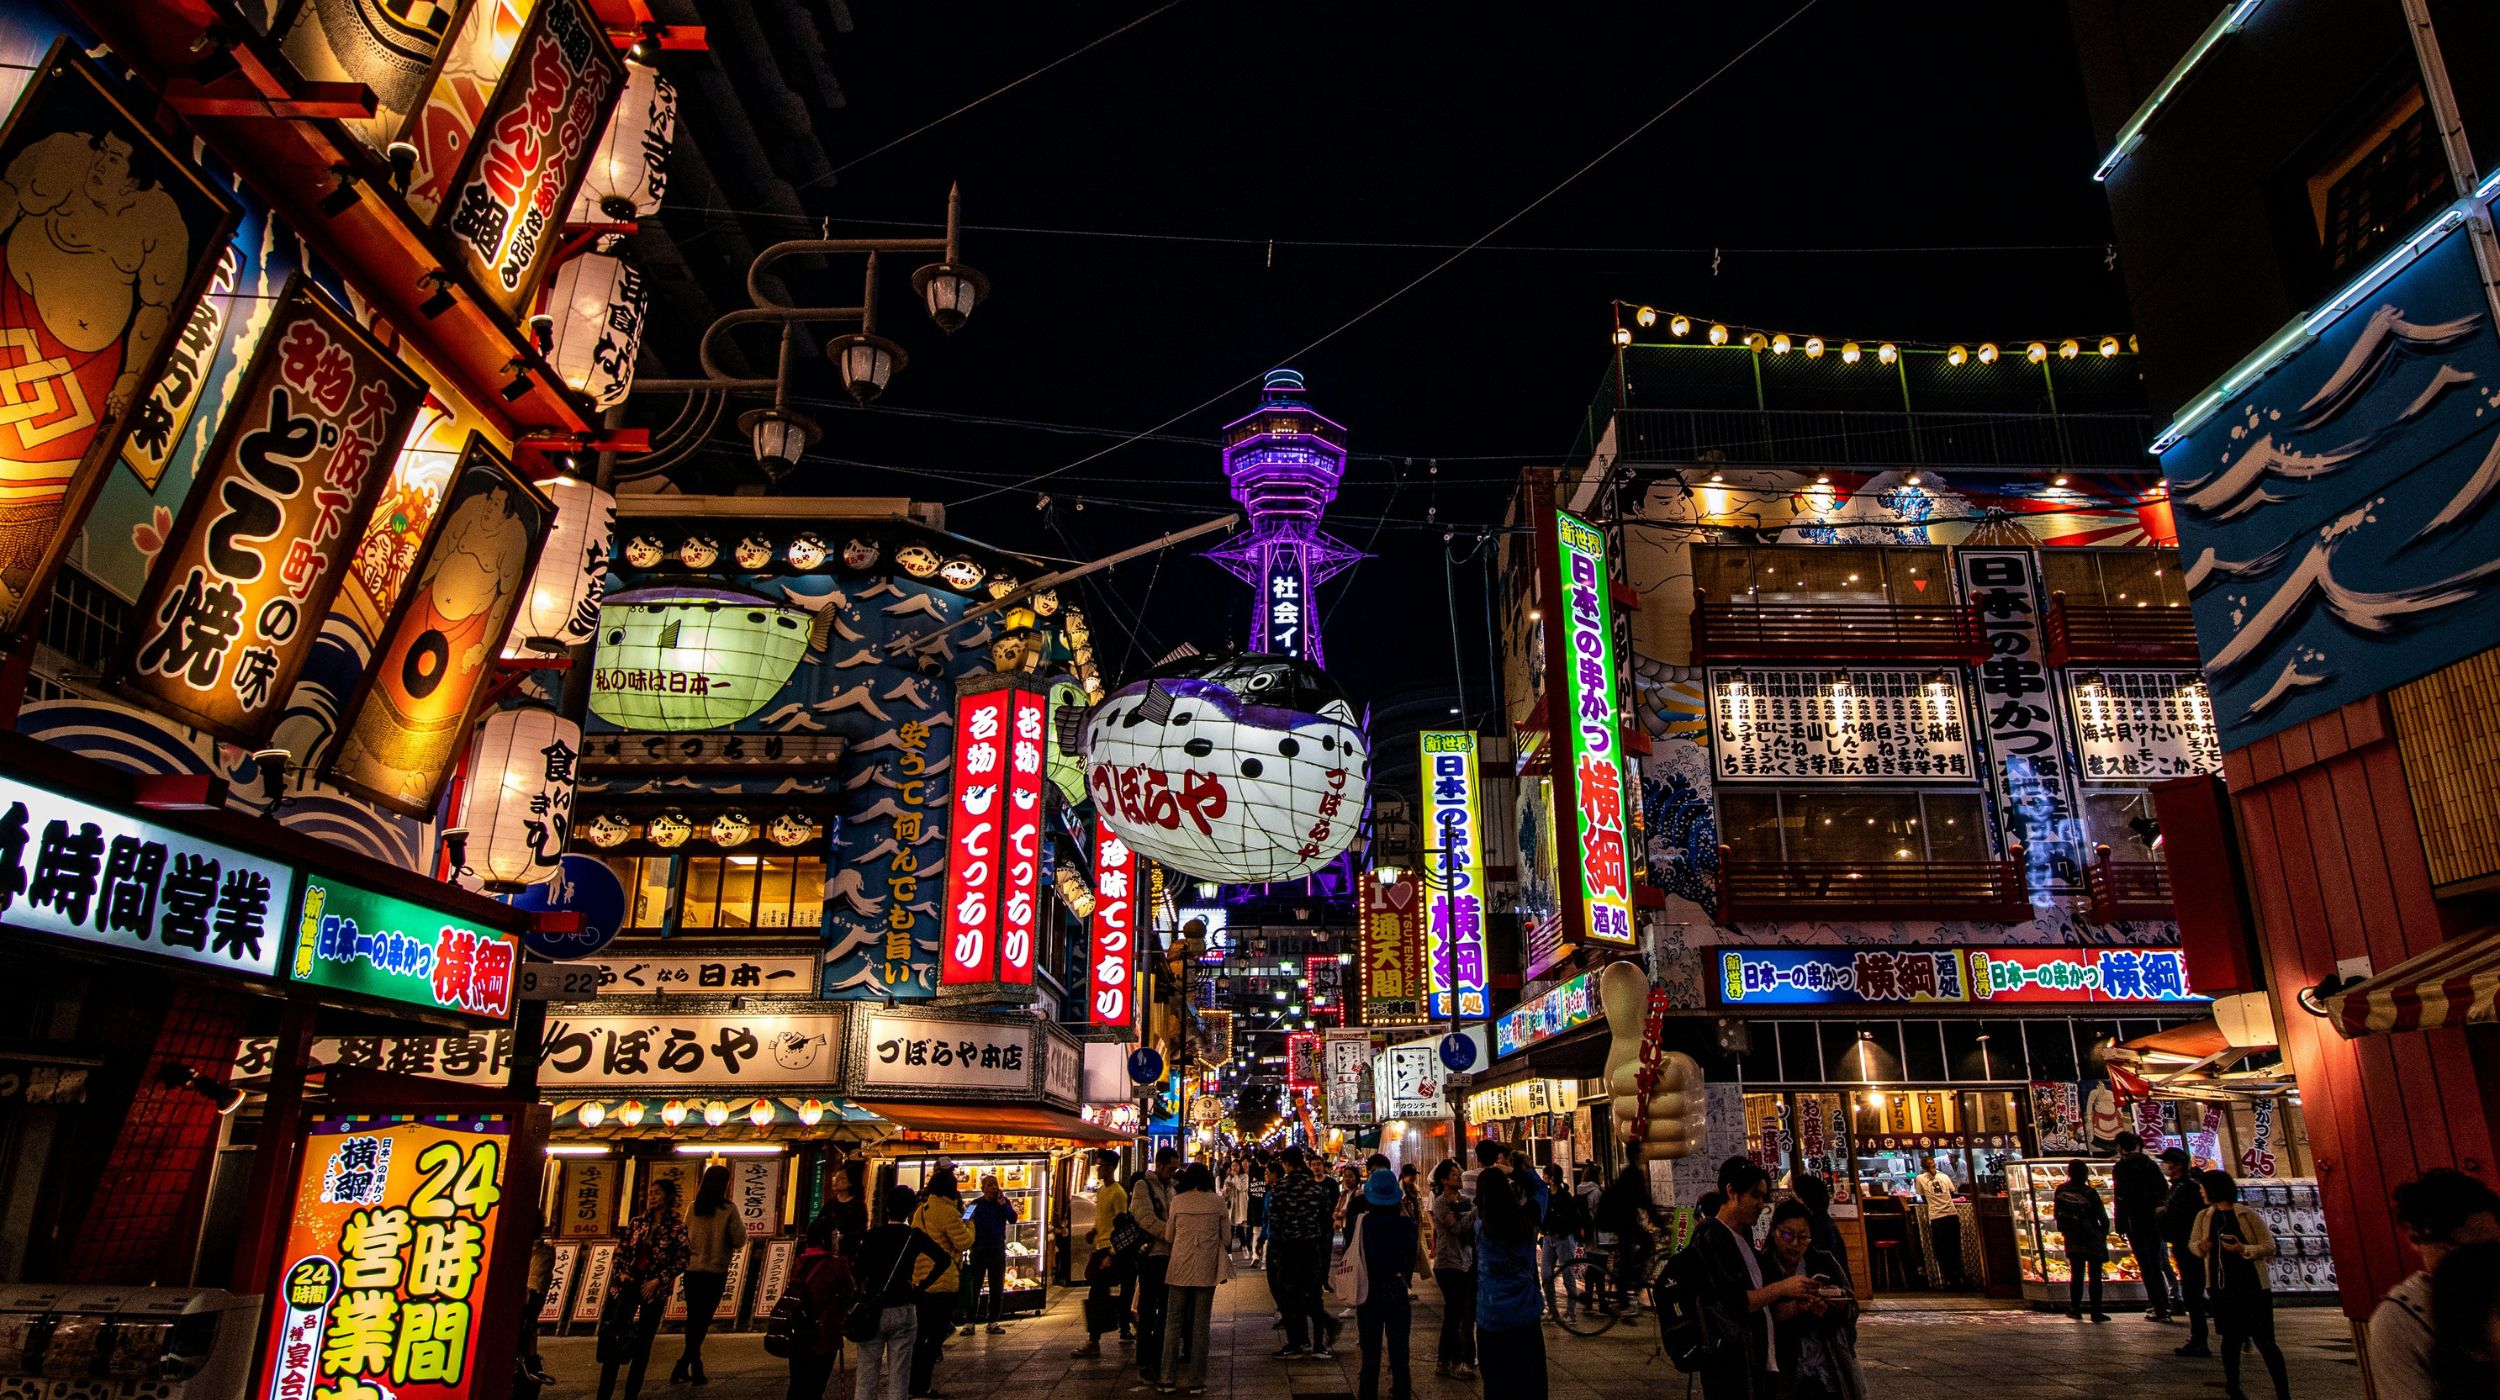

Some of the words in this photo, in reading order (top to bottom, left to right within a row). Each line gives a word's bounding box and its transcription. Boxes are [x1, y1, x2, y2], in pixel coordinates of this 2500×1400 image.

[1559, 518, 1602, 559] 新世界
[1272, 576, 1299, 658] 社会イ
[1570, 551, 1611, 752] 日本一の串かつ
[1969, 556, 2054, 755] 日本一の串かつ
[966, 705, 998, 774] 名物
[1014, 706, 1041, 774] 名物
[1424, 734, 1473, 753] 新世界
[1719, 722, 1740, 775] もち
[1738, 722, 1758, 775] うずら玉子
[1755, 722, 1776, 775] 紅しょうが
[1772, 722, 1792, 775] にんにく
[1789, 722, 1810, 775] 玉ねぎ
[1806, 722, 1826, 775] 山芋
[1824, 722, 1844, 775] しし唐
[1841, 722, 1862, 775] れんこん
[1859, 722, 1880, 775] 銀杏
[1876, 722, 1897, 775] 白ねぎ
[1893, 722, 1914, 775] さつま芋
[1910, 722, 1931, 775] じゃが芋
[1927, 722, 1949, 775] 茄子
[1945, 722, 1966, 775] 椎茸
[1998, 754, 2059, 778] 大阪
[2082, 723, 2104, 775] 海老
[2101, 723, 2123, 774] キス
[2117, 723, 2139, 774] 貝柱
[2133, 723, 2155, 774] サーモン
[2151, 723, 2172, 774] たこ
[2167, 724, 2190, 773] いか
[2201, 724, 2223, 774] ホルモン
[1092, 760, 1228, 836] づぼらや
[1298, 767, 1350, 864] づぼらや
[1434, 755, 1471, 891] 日本一の串かつ
[884, 720, 930, 985] 安うて何んでも旨い
[1578, 755, 1627, 900] 横綱
[1370, 882, 1388, 909] I
[1592, 903, 1629, 938] 酒処
[318, 915, 432, 977] 日本一の串かつ
[432, 926, 514, 1015] 横綱
[1371, 912, 1402, 998] 通天閣
[1403, 912, 1415, 996] TSUTENKAKU
[1431, 895, 1484, 989] 横綱
[565, 973, 593, 993] 22
[1725, 953, 1743, 999] 新世界
[1743, 961, 1854, 990] 日本一の串かつ
[1854, 951, 1938, 1000] 横綱
[1937, 953, 1962, 999] 酒処
[1972, 953, 1992, 999] 新世界
[1991, 962, 2100, 991] 日本一の串かつ
[2100, 951, 2181, 999] 横綱
[550, 1026, 759, 1075] づぼらや
[876, 1038, 1023, 1071] づぼらや本店
[335, 1137, 378, 1203] 横綱
[2241, 1148, 2277, 1178] 45
[574, 1225, 598, 1233] 840
[291, 1286, 328, 1304] 時間
[294, 1264, 331, 1285] 24
